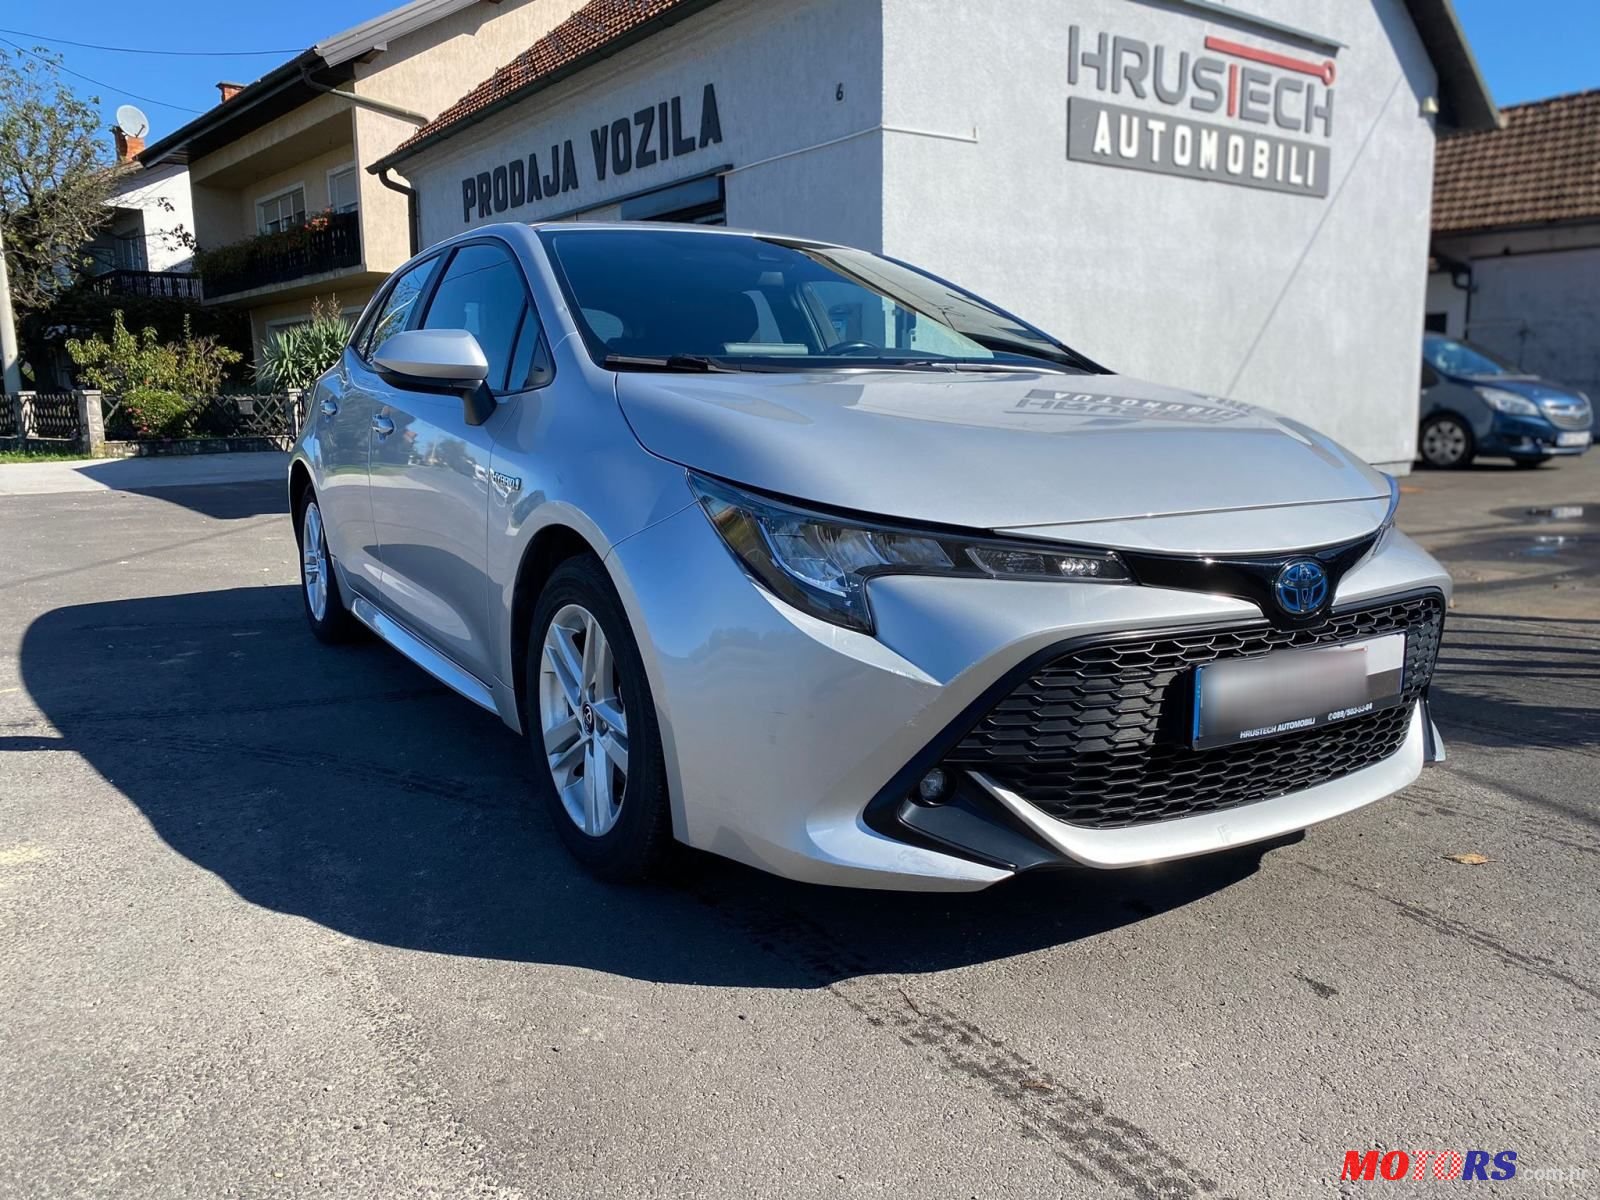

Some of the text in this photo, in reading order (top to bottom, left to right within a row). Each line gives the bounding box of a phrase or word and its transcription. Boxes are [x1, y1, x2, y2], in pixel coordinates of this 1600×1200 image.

[836, 82, 844, 101] 6
[1067, 24, 1335, 138] HRUSTECH
[462, 83, 723, 223] PRODAJA VOZILA
[1093, 109, 1315, 187] AUTOMOBILI
[1240, 717, 1316, 739] HRUSTECH AUTOMOBILI
